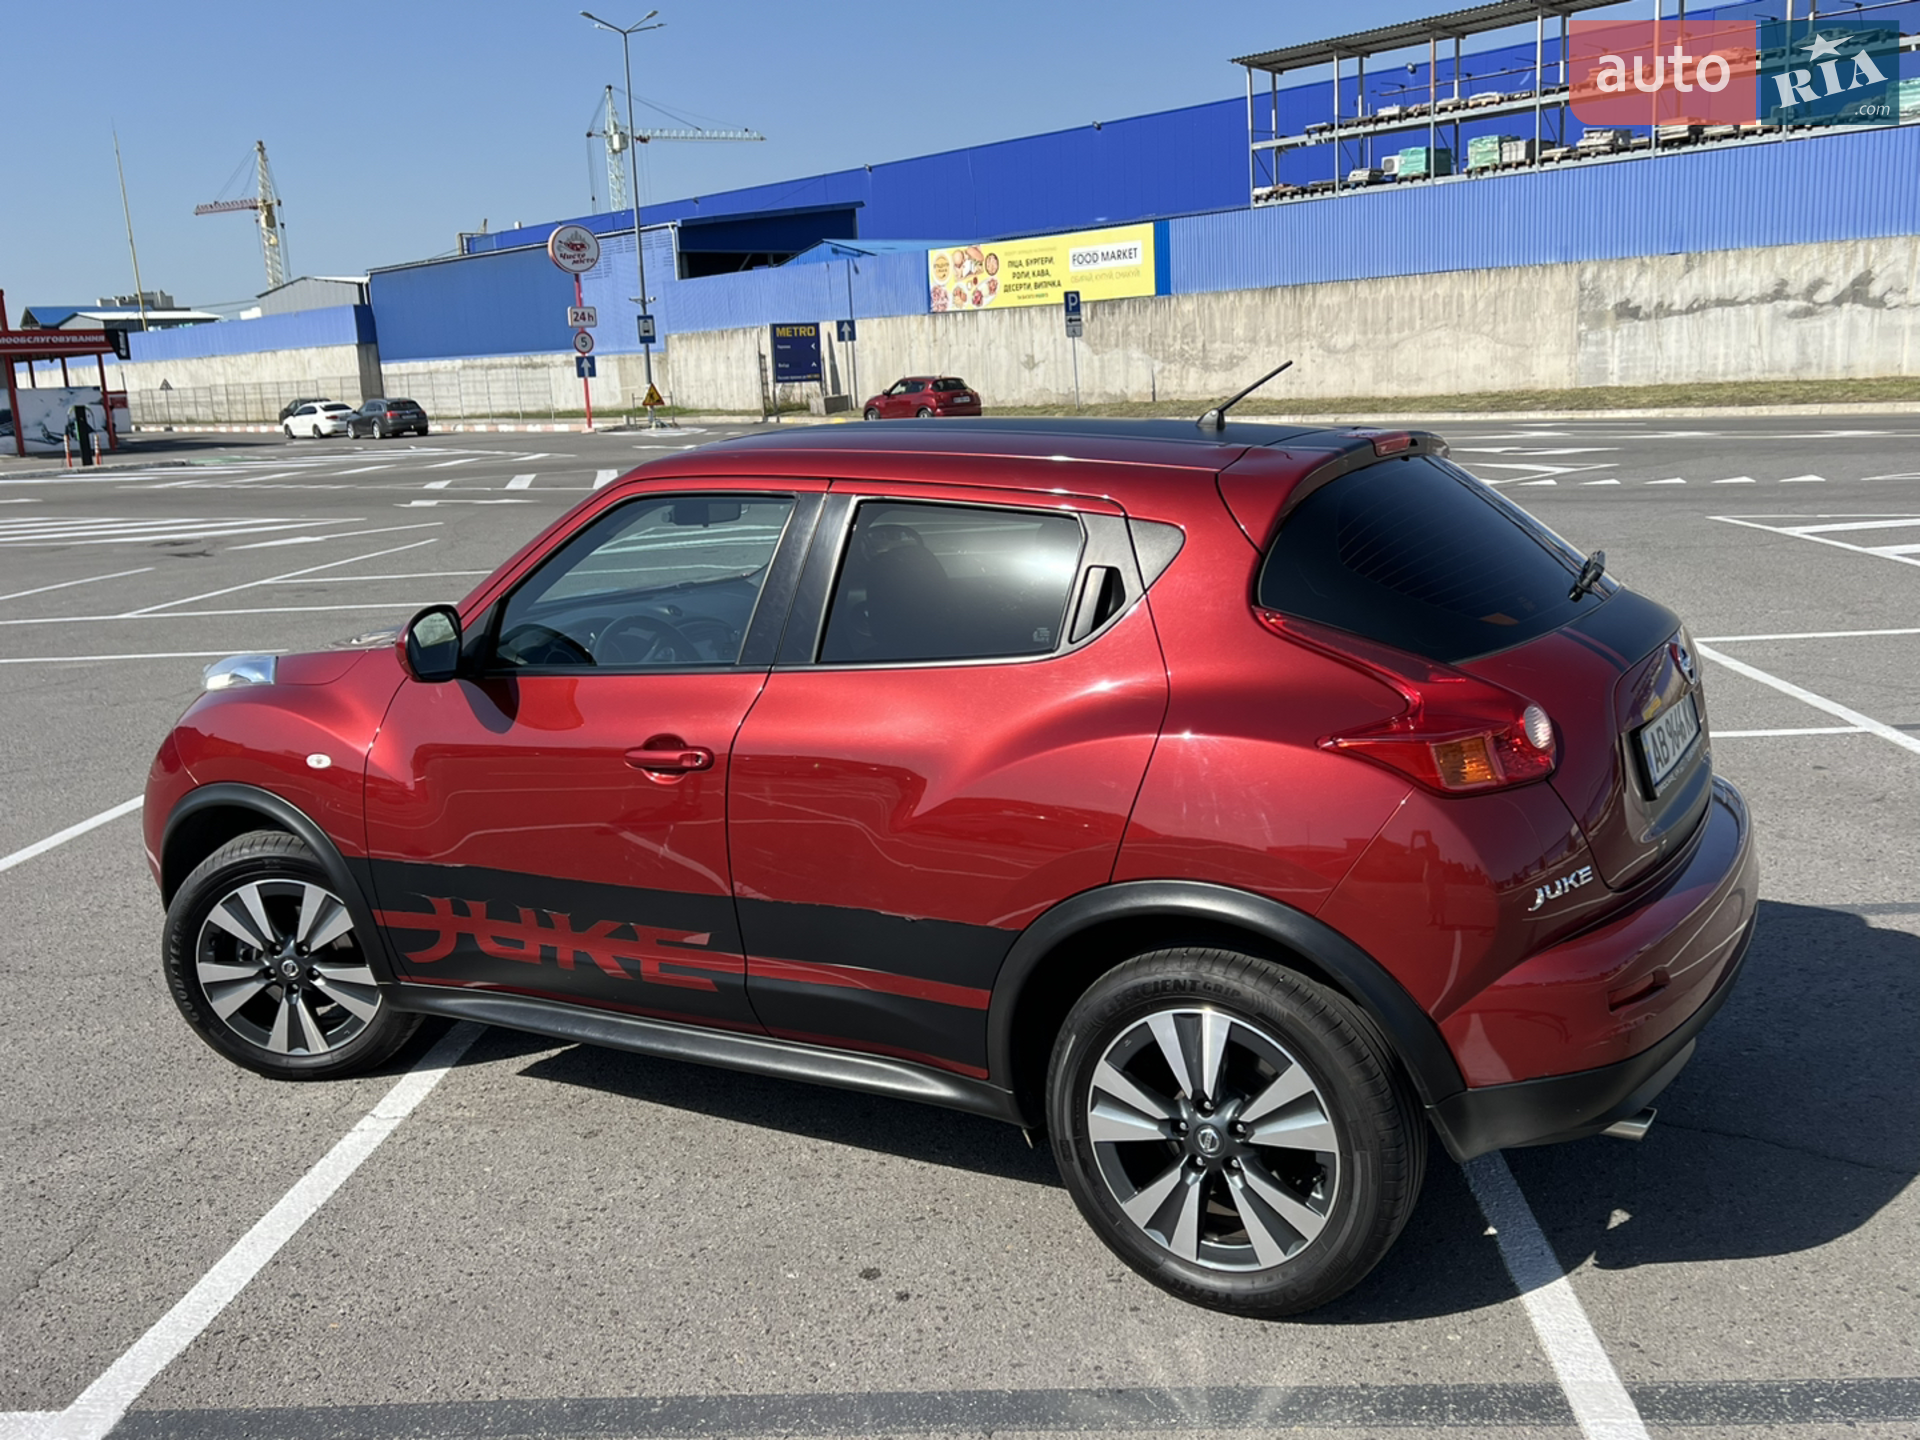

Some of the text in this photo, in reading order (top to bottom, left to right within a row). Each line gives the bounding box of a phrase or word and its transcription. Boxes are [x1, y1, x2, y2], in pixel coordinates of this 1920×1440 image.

[1072, 247, 1138, 265] FOOD MARKET
[1068, 293, 1078, 311] P
[775, 325, 817, 337] METRO
[581, 337, 588, 348] 5
[1527, 865, 1594, 912] JUKE
[402, 895, 719, 992] JUKE
